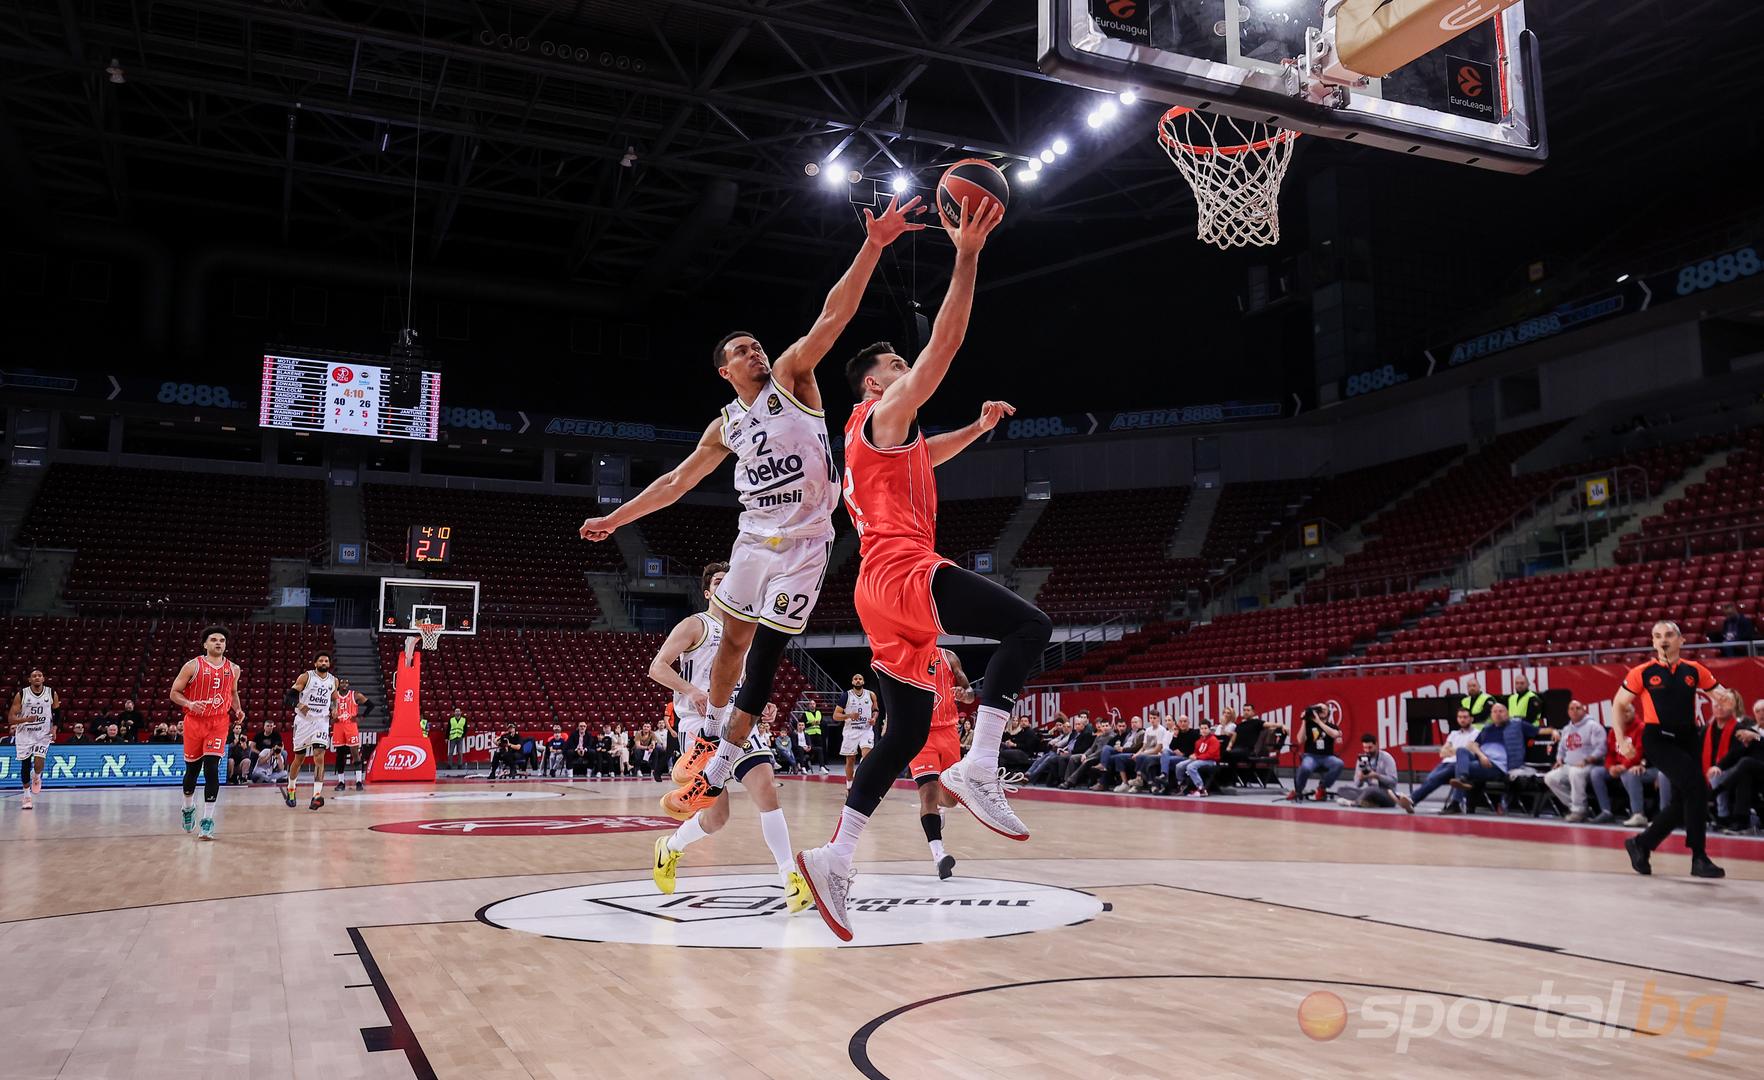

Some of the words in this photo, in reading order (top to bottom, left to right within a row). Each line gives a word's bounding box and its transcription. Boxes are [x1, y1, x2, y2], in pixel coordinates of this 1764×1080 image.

[1095, 16, 1148, 36] EuroLeague
[1450, 95, 1493, 112] EuroLeague
[1517, 314, 1561, 341] 8888
[334, 398, 345, 406] 40
[344, 389, 364, 398] 4:10
[335, 408, 341, 416] 2
[360, 400, 370, 408] 26
[1182, 406, 1224, 423] 8888
[616, 423, 657, 441] 8888
[752, 431, 772, 456] 2
[745, 455, 803, 486] beko
[757, 490, 803, 507] misli
[422, 527, 450, 539] 4:10
[416, 541, 447, 558] 21
[788, 594, 809, 620] 2
[212, 678, 221, 688] 3
[310, 694, 329, 704] beko
[213, 739, 222, 749] 3
[847, 897, 1034, 906] שקעות
